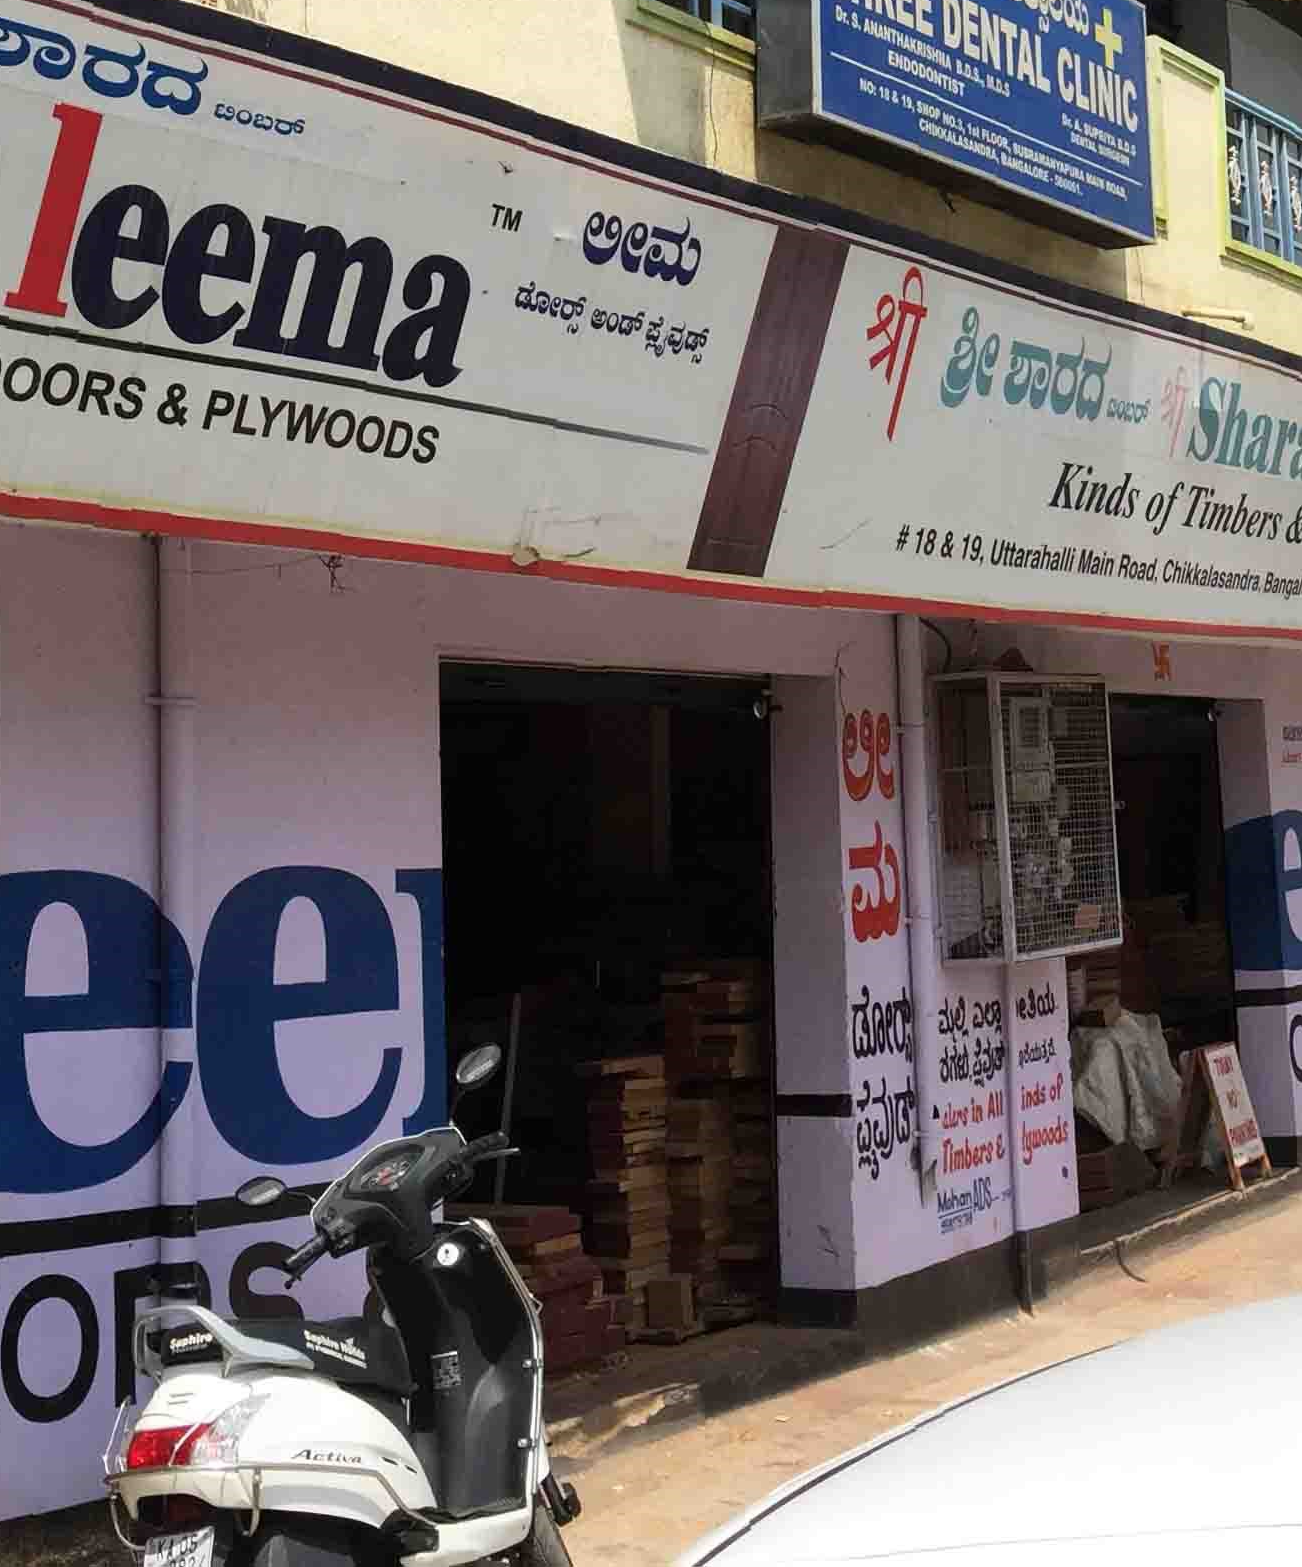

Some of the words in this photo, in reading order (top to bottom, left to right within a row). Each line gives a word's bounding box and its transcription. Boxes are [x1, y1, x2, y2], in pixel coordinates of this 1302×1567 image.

[835, 5, 850, 26] Dr.
[864, 19, 952, 71] ANANTHAKRISHNA
[888, 50, 965, 97] ENDODONTIST
[1057, 47, 1139, 133] CLINIC
[213, 102, 306, 136] ಟಿಂಬರ್
[878, 85, 890, 101] 18
[916, 100, 942, 123] SHOP
[981, 126, 1012, 152] FLOOR,
[1012, 140, 1085, 181] SUBRAMANYAPURA
[4, 102, 472, 389] leema
[491, 203, 523, 232] TM
[583, 211, 702, 286] ಲೀಮ
[514, 280, 587, 335] ಡೋರ್ಸ್
[591, 308, 646, 337] ಅಂಡ್
[940, 306, 1000, 408] ಶ್ರೀ
[1003, 336, 1113, 421] ಶಾರದ
[156, 383, 189, 428] &
[204, 389, 441, 465] PLYWOODS
[1048, 462, 1140, 518] Kinds
[1145, 481, 1185, 535] of
[1182, 485, 1282, 541] Timbers
[896, 524, 910, 551] #
[914, 527, 938, 556] 18
[940, 530, 955, 559] &
[961, 533, 985, 566] 19,
[990, 538, 1076, 572] Uttarahalli
[1078, 548, 1116, 578] Main
[971, 1097, 984, 1122] in
[987, 1091, 1003, 1120] All
[1021, 1081, 1046, 1112] inds
[1049, 1073, 1064, 1101] of
[942, 1136, 992, 1175] Timbers
[1021, 1115, 1069, 1165] lywoods
[973, 1176, 992, 1212] ADS
[291, 1448, 362, 1465] Activa
